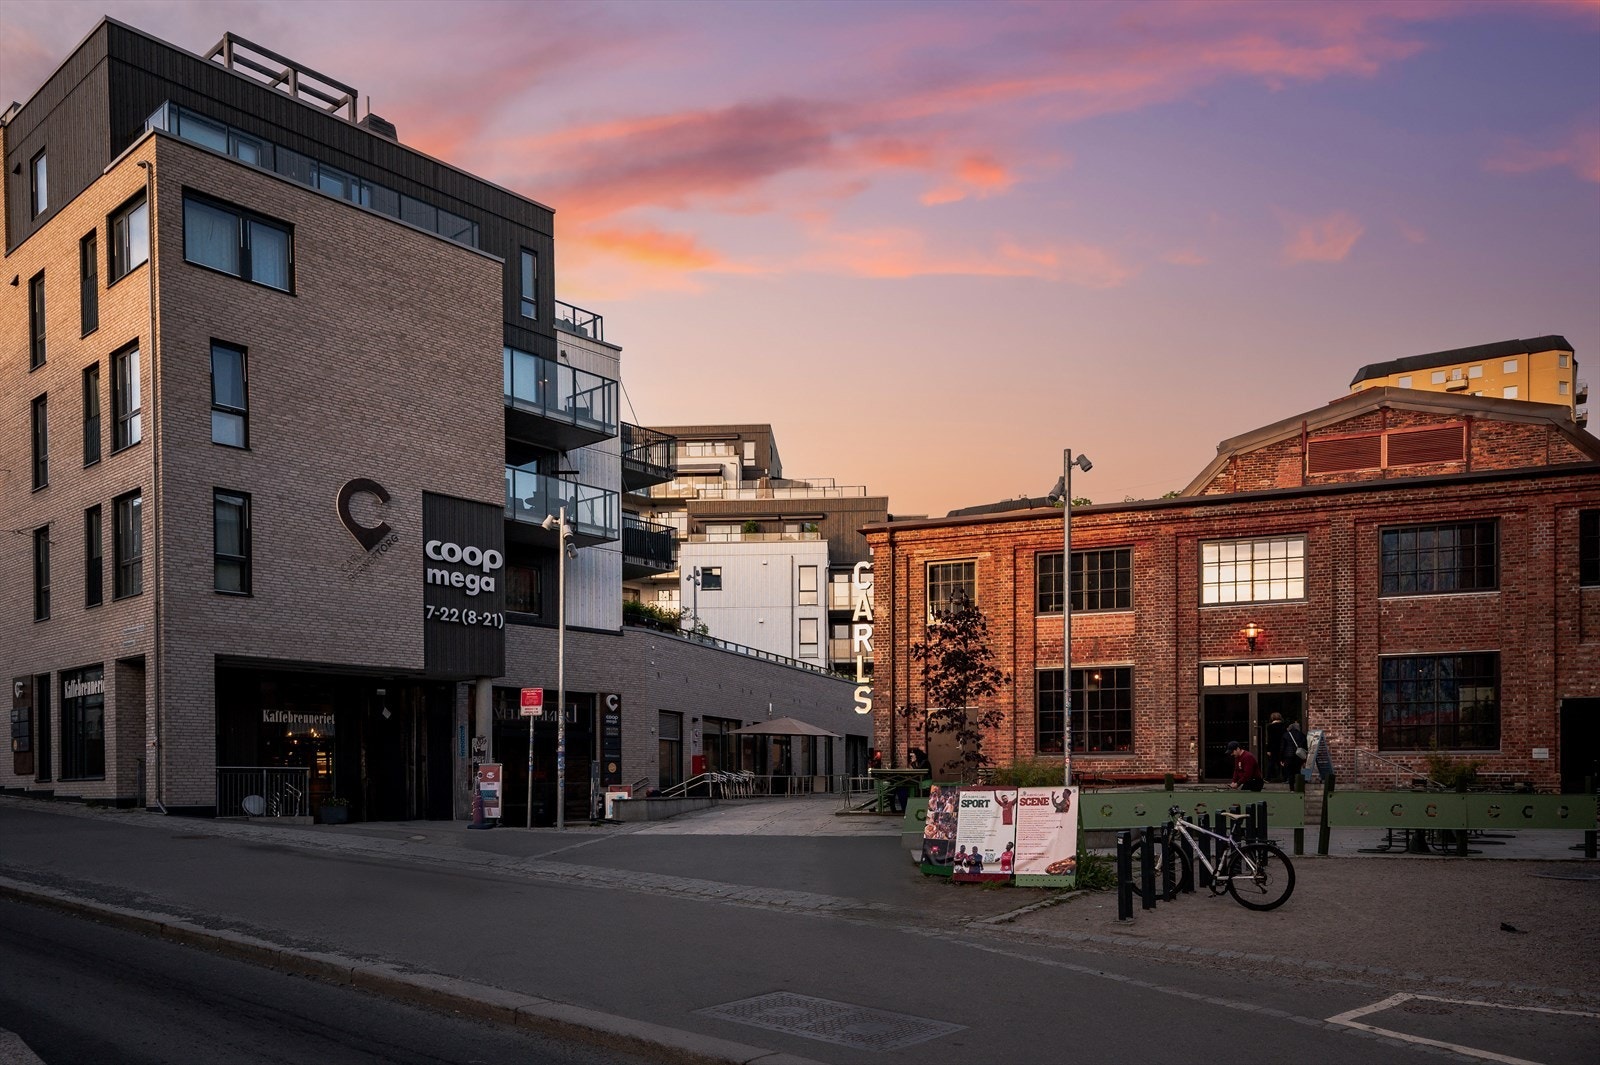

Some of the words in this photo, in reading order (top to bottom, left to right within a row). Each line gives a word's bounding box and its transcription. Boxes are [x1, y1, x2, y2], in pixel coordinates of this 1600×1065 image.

[425, 540, 504, 573] coop
[426, 568, 495, 596] mega
[425, 605, 460, 623] 7-22
[461, 608, 504, 630] (8-21)
[852, 560, 874, 714] CARLS
[262, 709, 336, 725] Kaffebrenneriet
[961, 799, 991, 808] SPORT
[1019, 797, 1050, 806] SCENE
